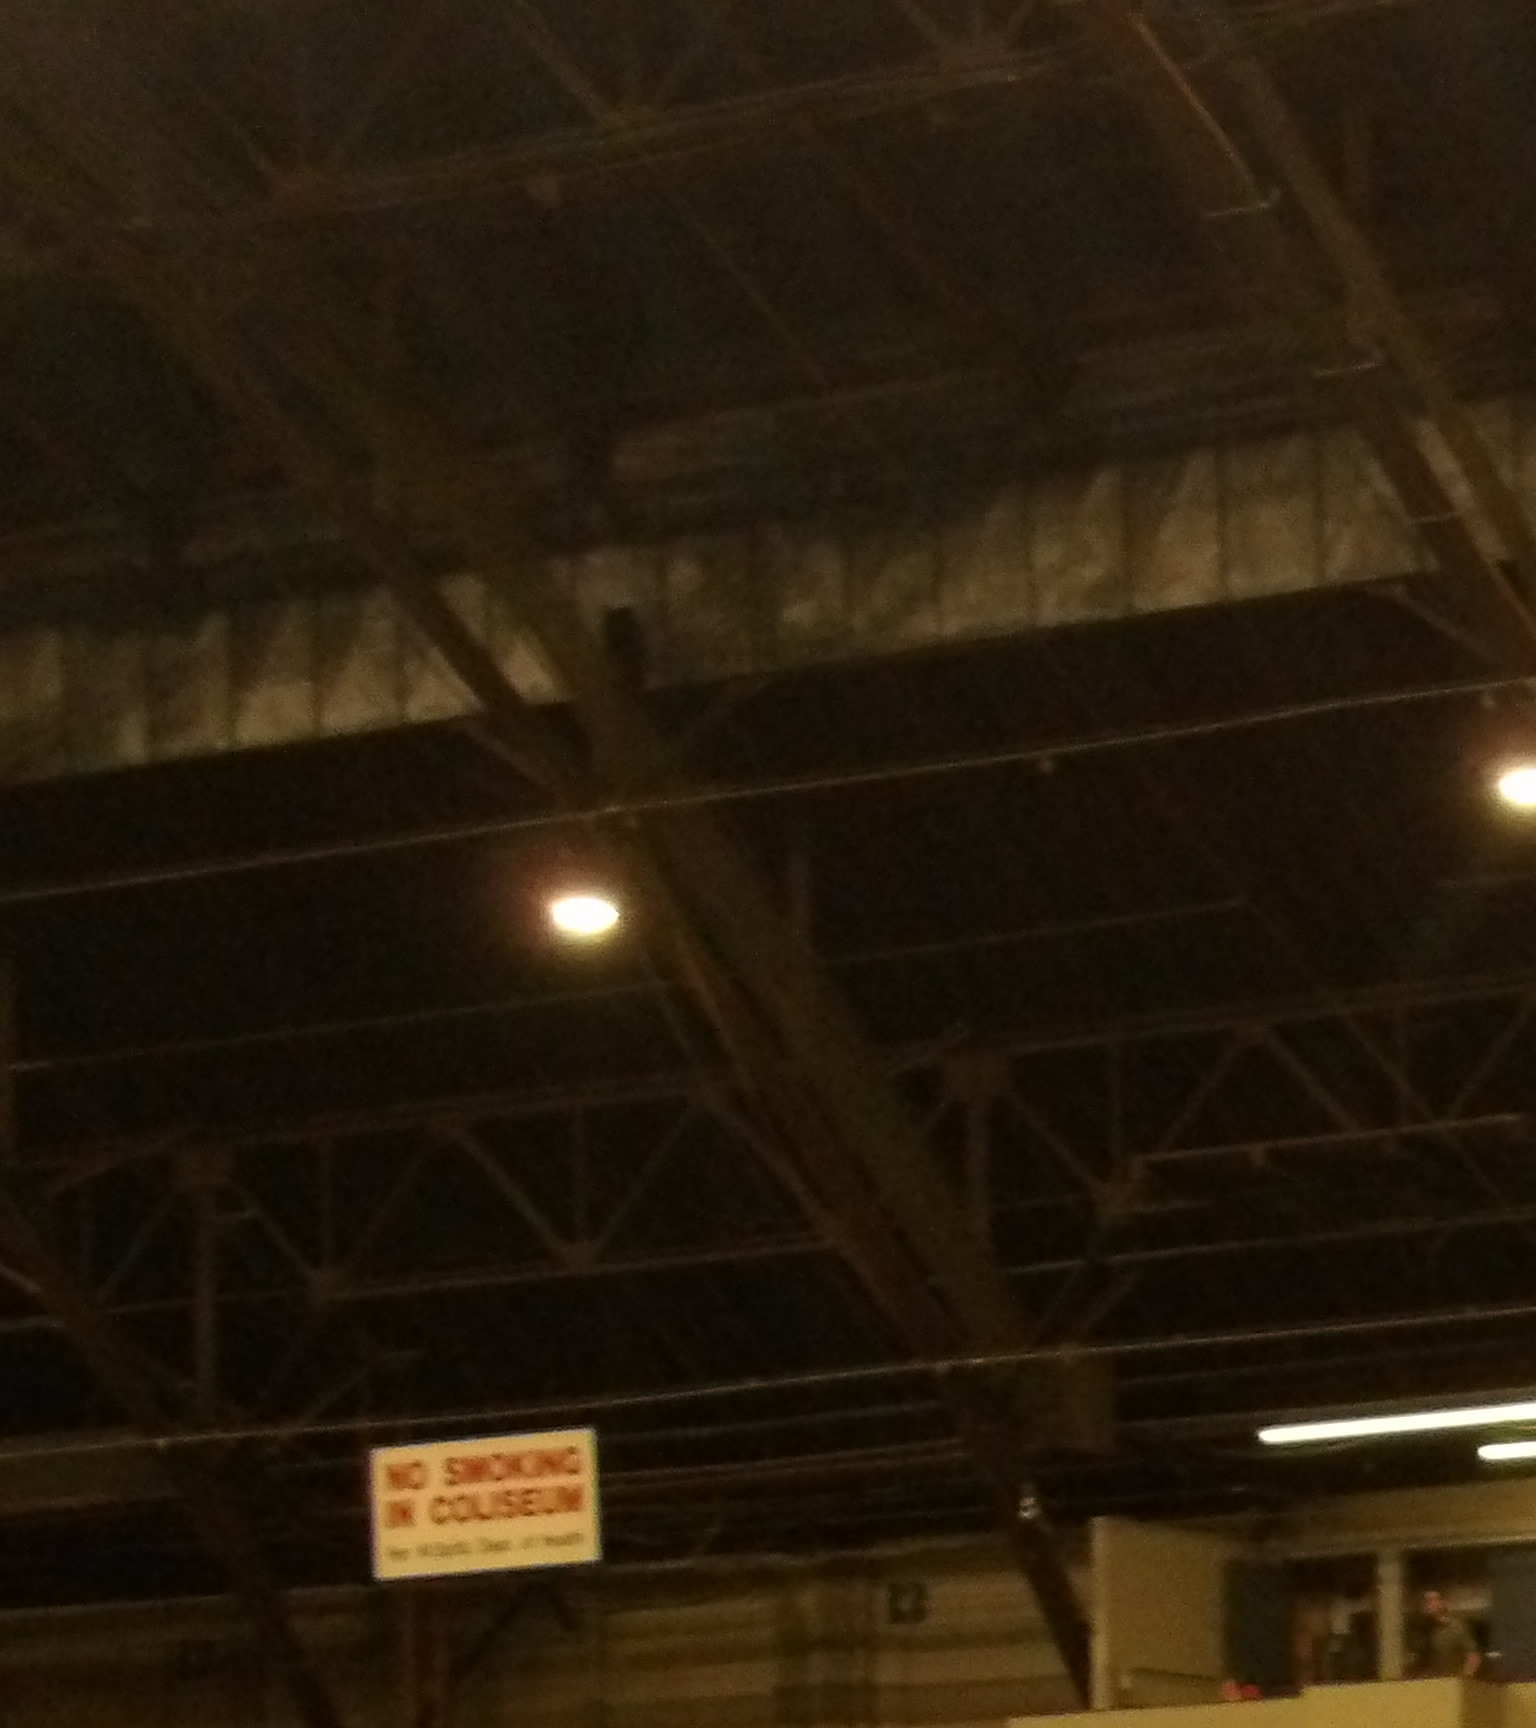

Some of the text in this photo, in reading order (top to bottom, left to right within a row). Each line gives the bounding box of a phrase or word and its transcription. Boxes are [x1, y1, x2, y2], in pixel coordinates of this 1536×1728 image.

[386, 1447, 581, 1490] NO SMOKING
[431, 1487, 582, 1524] COLISEUM
